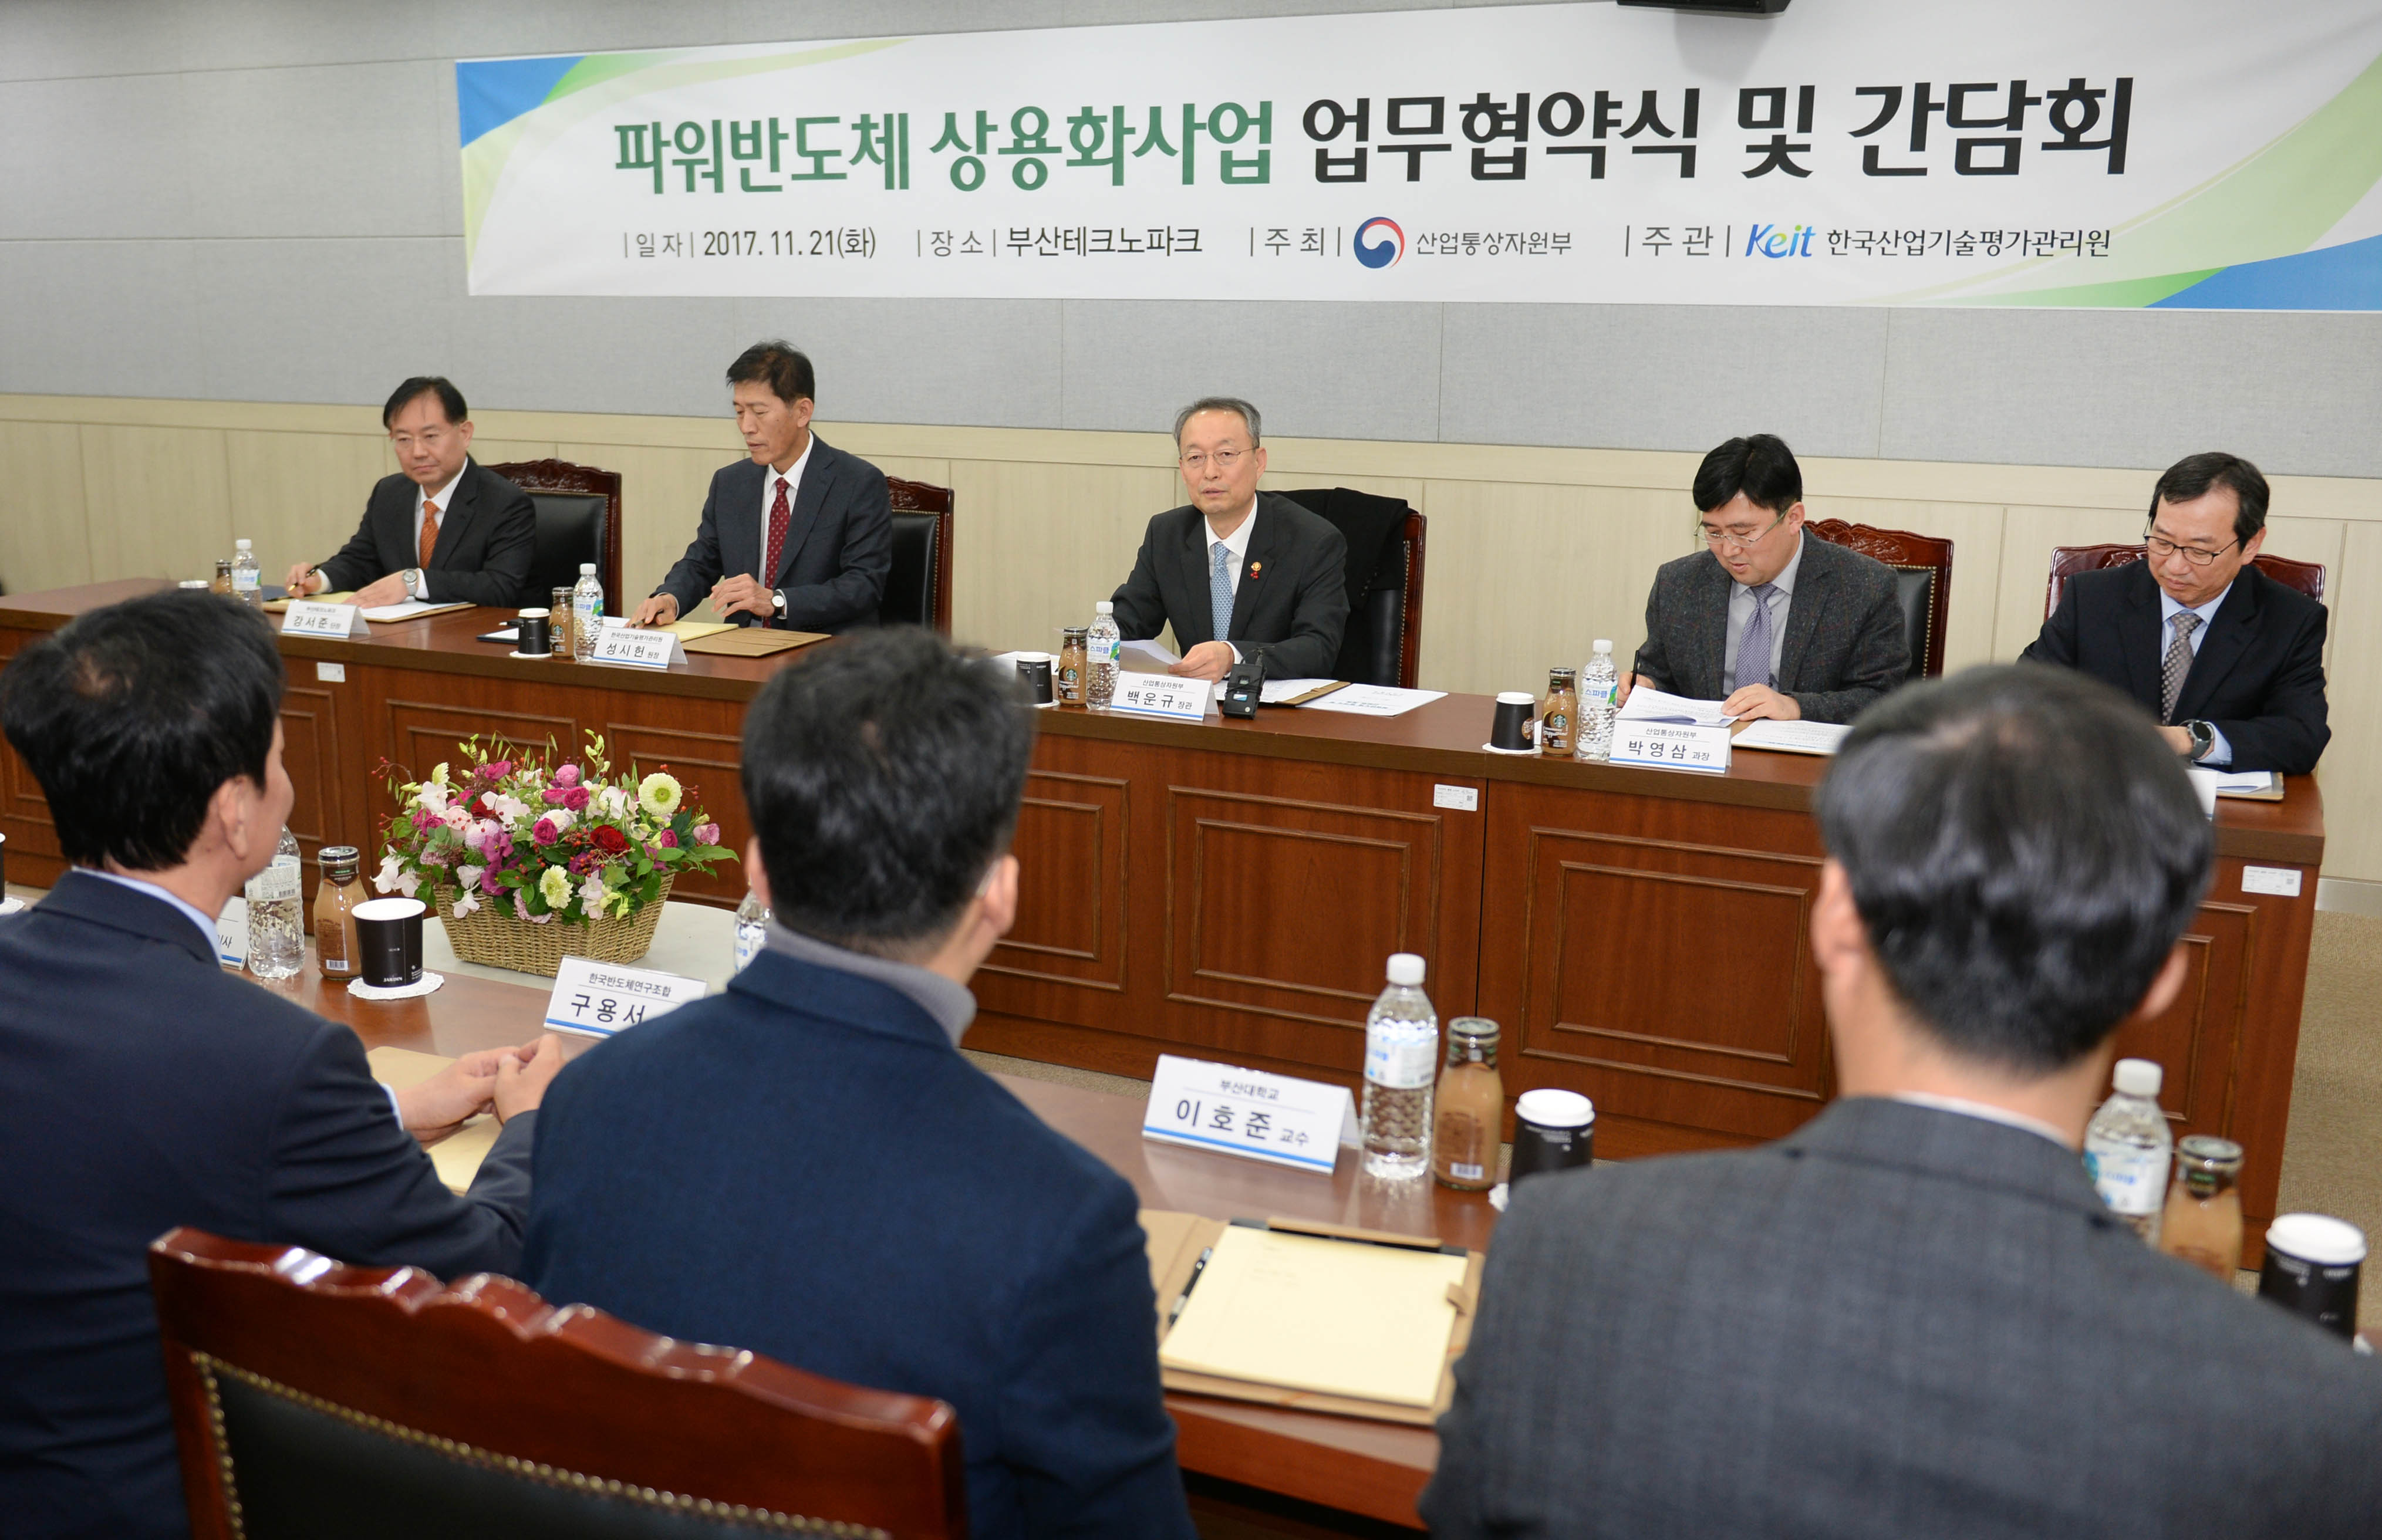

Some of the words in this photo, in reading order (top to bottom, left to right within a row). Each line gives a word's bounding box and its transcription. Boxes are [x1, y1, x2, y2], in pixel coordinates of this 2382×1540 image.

[615, 113, 910, 195] 파워반도체
[930, 101, 1274, 192] 상용화사업
[1303, 87, 1701, 184] 업무협약식
[1737, 85, 1816, 180] 및
[1848, 77, 2135, 178] 간담회
[1007, 225, 1203, 258] 부산테크노파크
[1418, 231, 1573, 256] 산업통상자원부
[1745, 224, 1818, 259] Keit
[1827, 229, 2111, 258] 한국산업기술평가관리원
[1142, 679, 1184, 690] 산업통상자원부
[1177, 701, 1193, 710] 장관
[1645, 727, 1698, 739] 산업통상자원부
[1692, 751, 1710, 761] 과장
[588, 972, 672, 998] 한국반도체연구조합
[1220, 1079, 1280, 1100] 부산대학교
[1280, 1127, 1309, 1147] 교수
